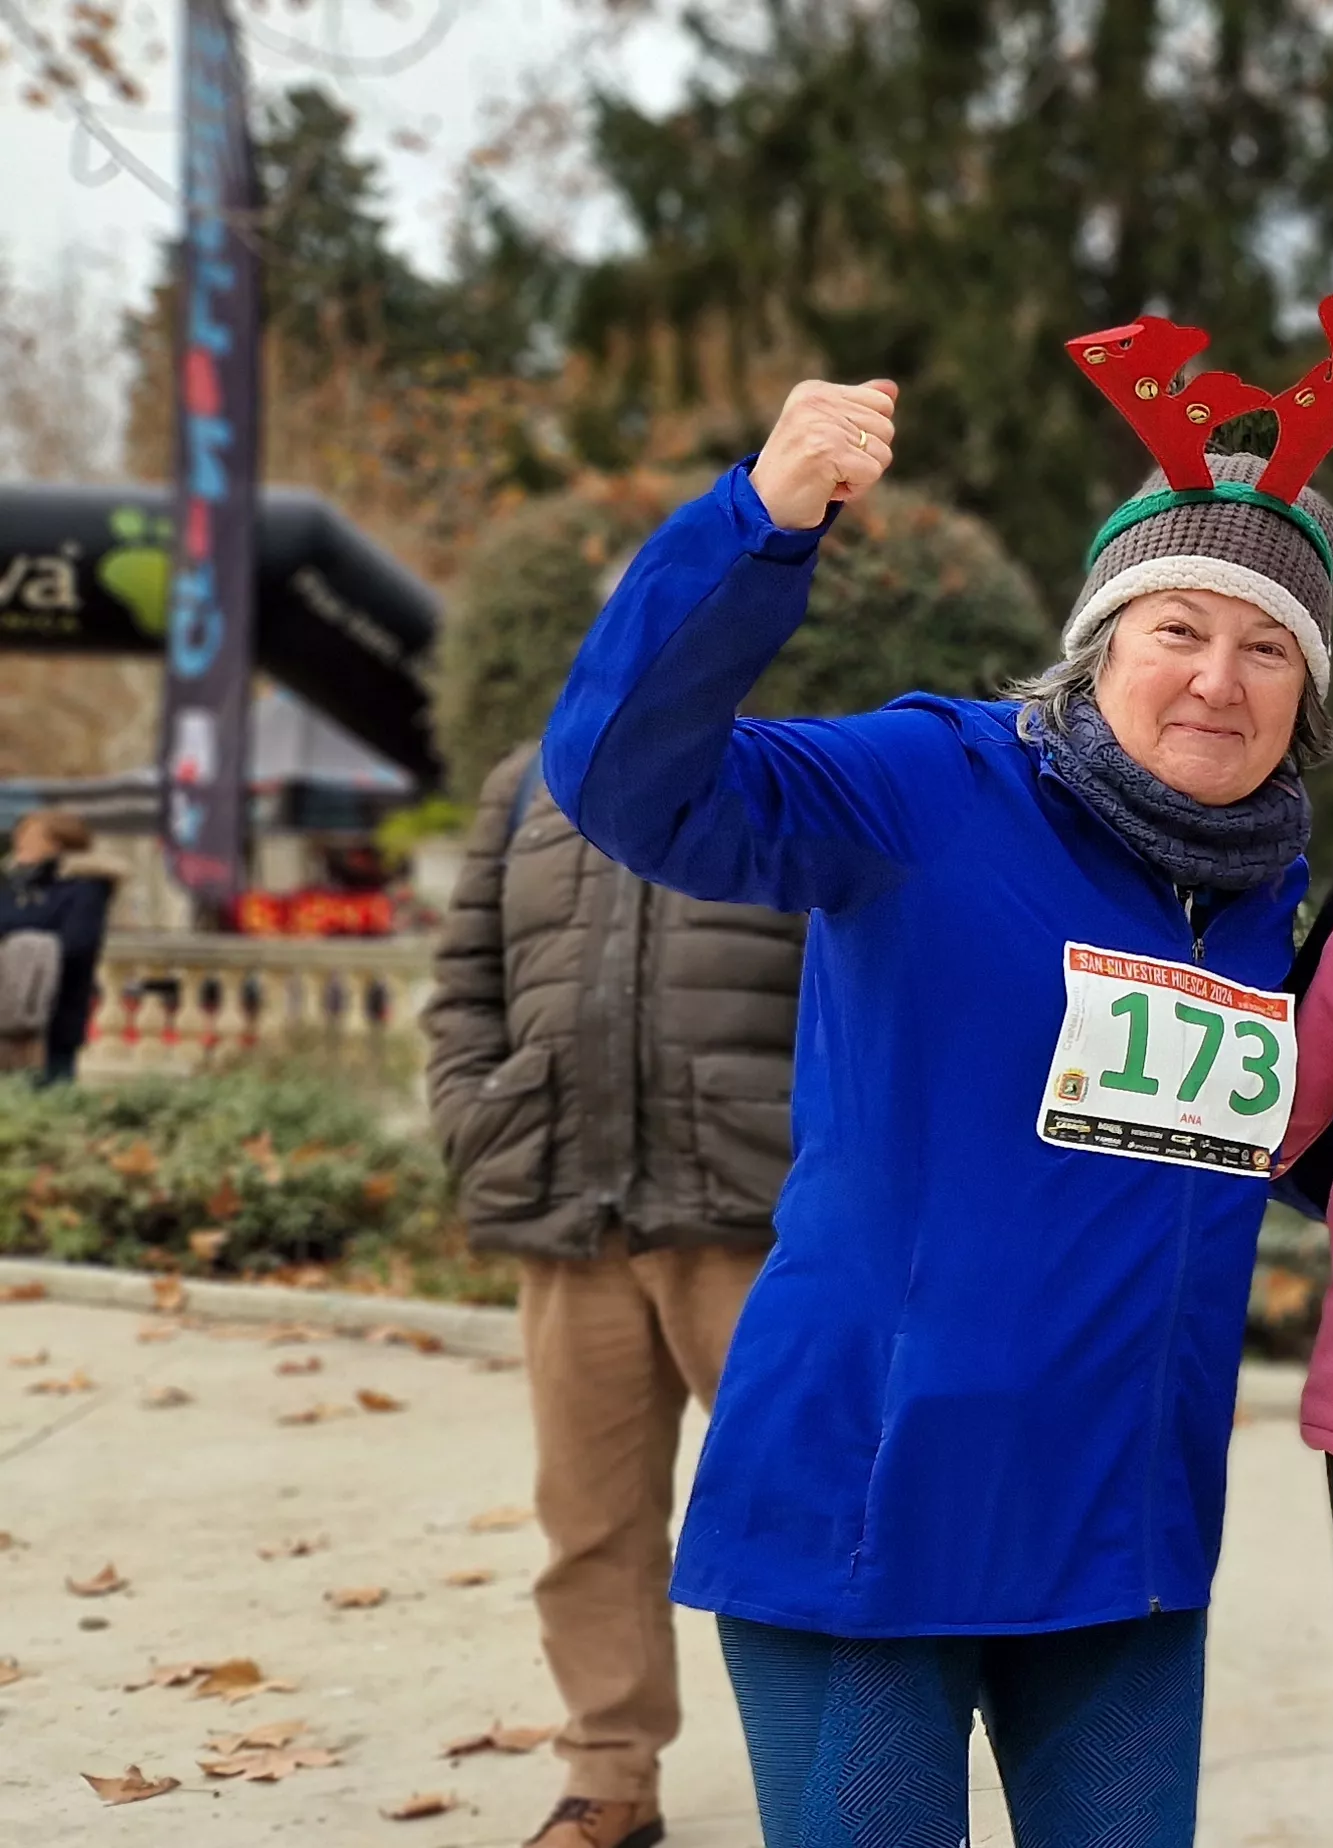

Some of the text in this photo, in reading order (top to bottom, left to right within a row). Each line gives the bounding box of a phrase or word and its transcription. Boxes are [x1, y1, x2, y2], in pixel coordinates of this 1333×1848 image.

[1079, 952, 1233, 1006] SAN SILVESTRE HUESCA 2024
[1100, 991, 1280, 1116] 173
[1180, 1113, 1202, 1126] ANA
